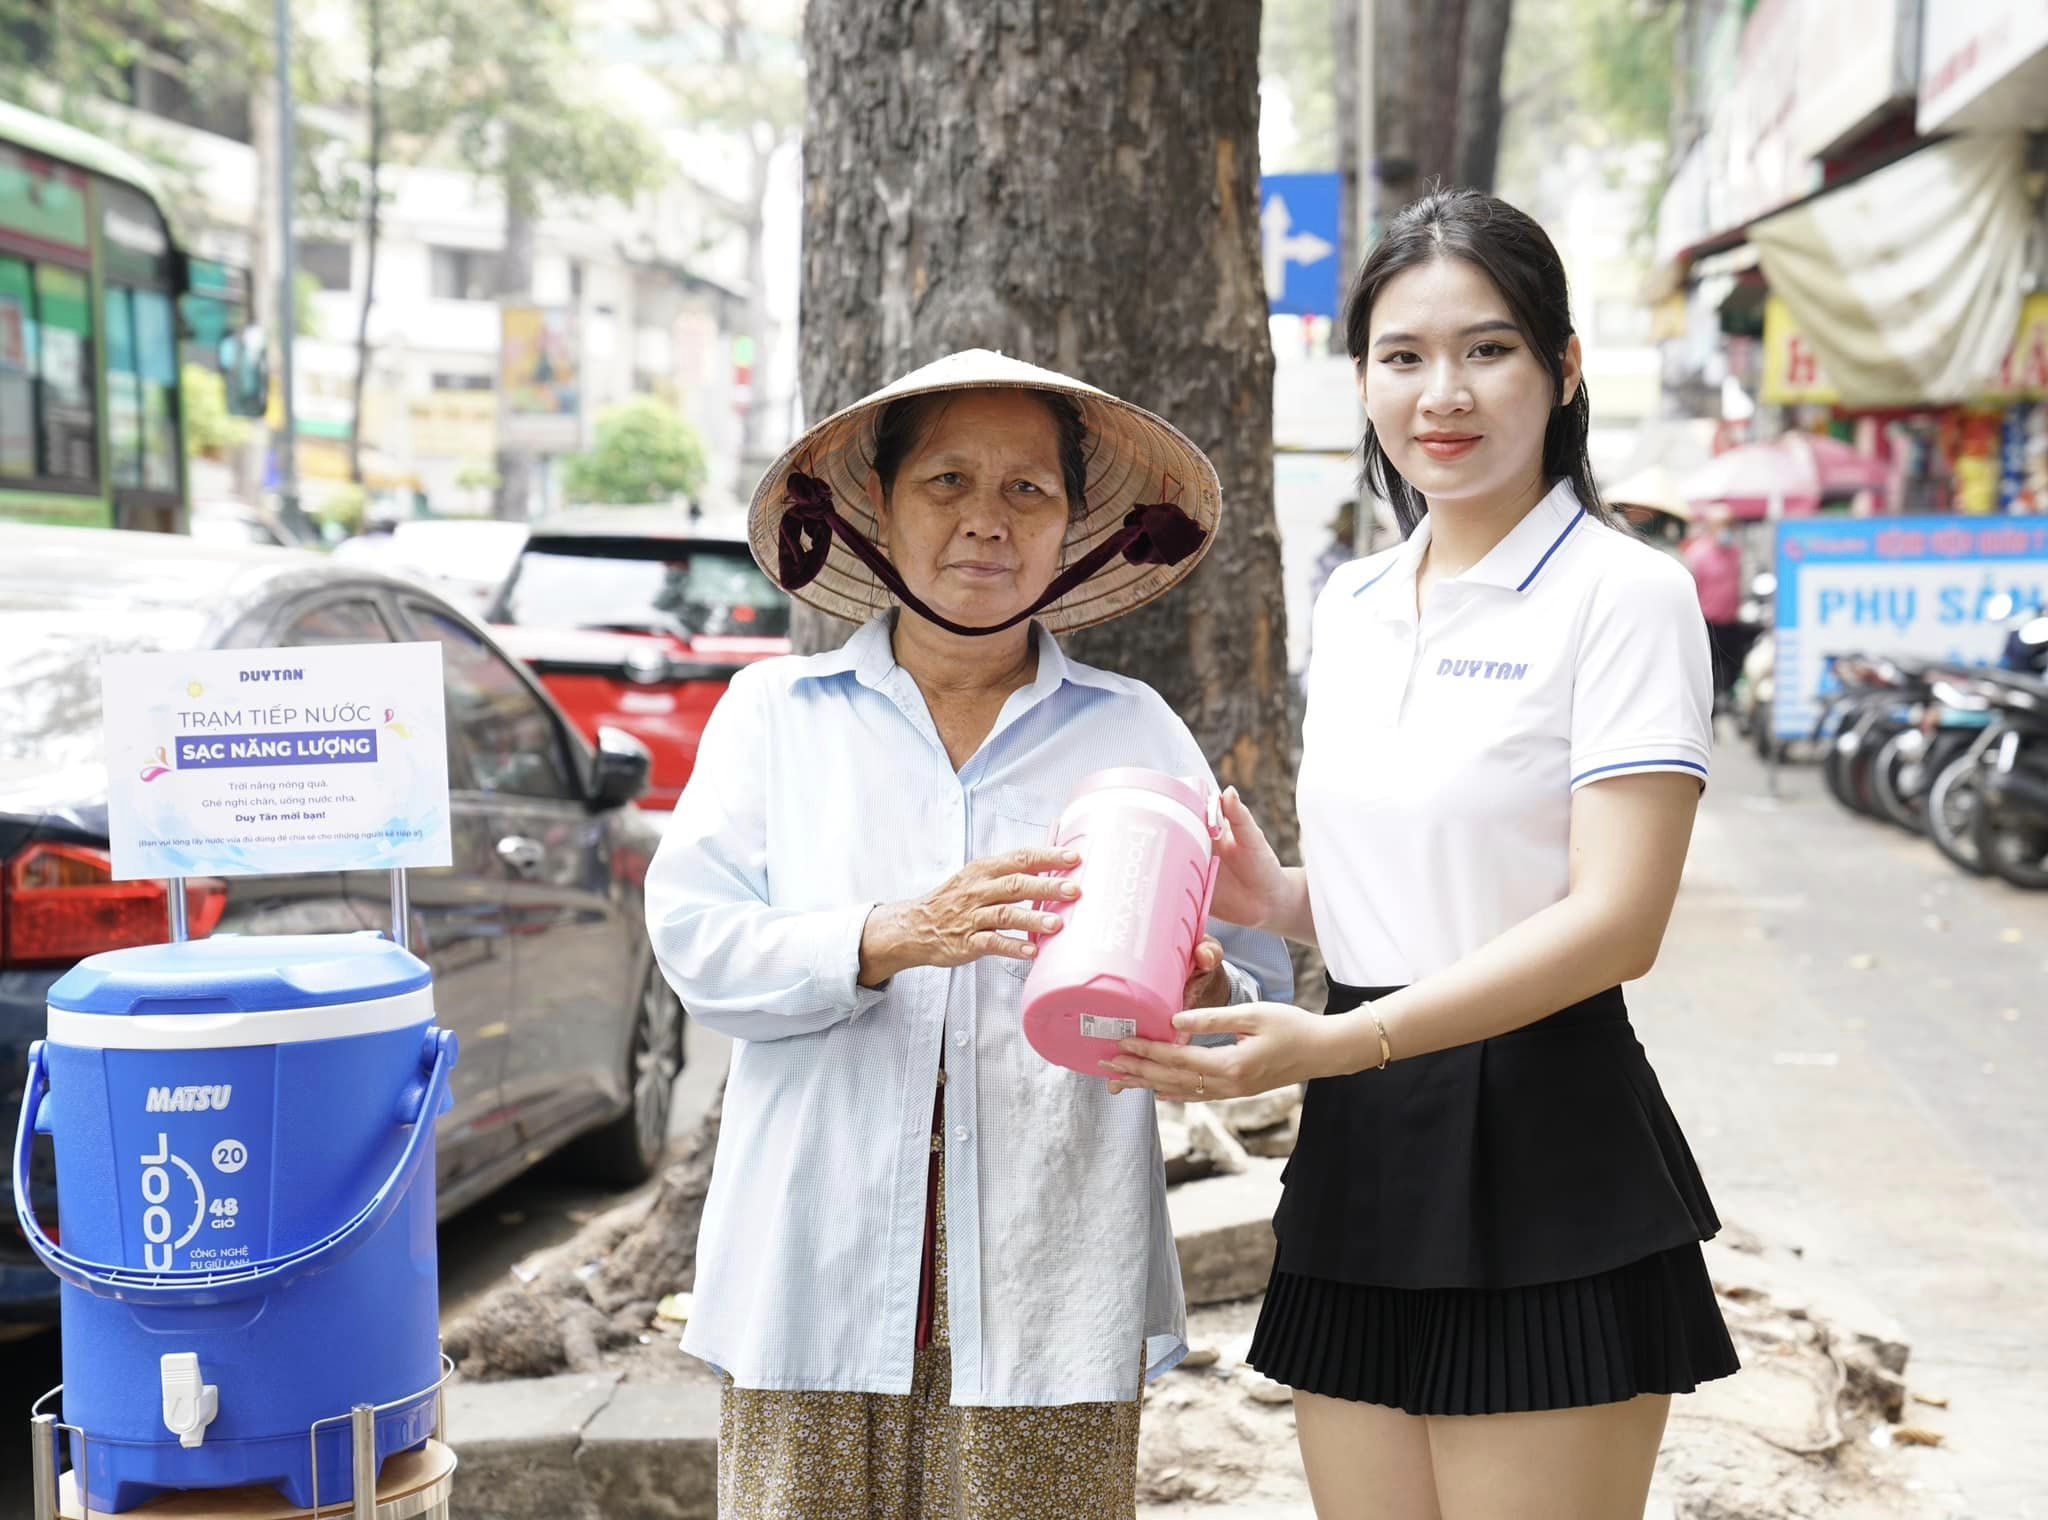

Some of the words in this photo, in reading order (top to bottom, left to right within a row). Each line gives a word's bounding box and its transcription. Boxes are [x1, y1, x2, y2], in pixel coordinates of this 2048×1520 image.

[239, 668, 304, 683] DUYTAN
[1436, 658, 1529, 680] DUYTAN
[178, 709, 242, 731] TRẠM
[248, 703, 298, 726] TIẾP
[305, 702, 372, 724] NƯỚC
[182, 743, 225, 764] SẠC
[231, 738, 292, 759] NĂNG
[297, 737, 371, 760] LƯỢNG
[235, 813, 256, 824] Duy
[145, 1084, 232, 1113] MATSU
[217, 1147, 244, 1165] 20
[209, 1197, 239, 1217] 48
[190, 1247, 217, 1259] CÔNG
[220, 1244, 249, 1257] NGHỆ
